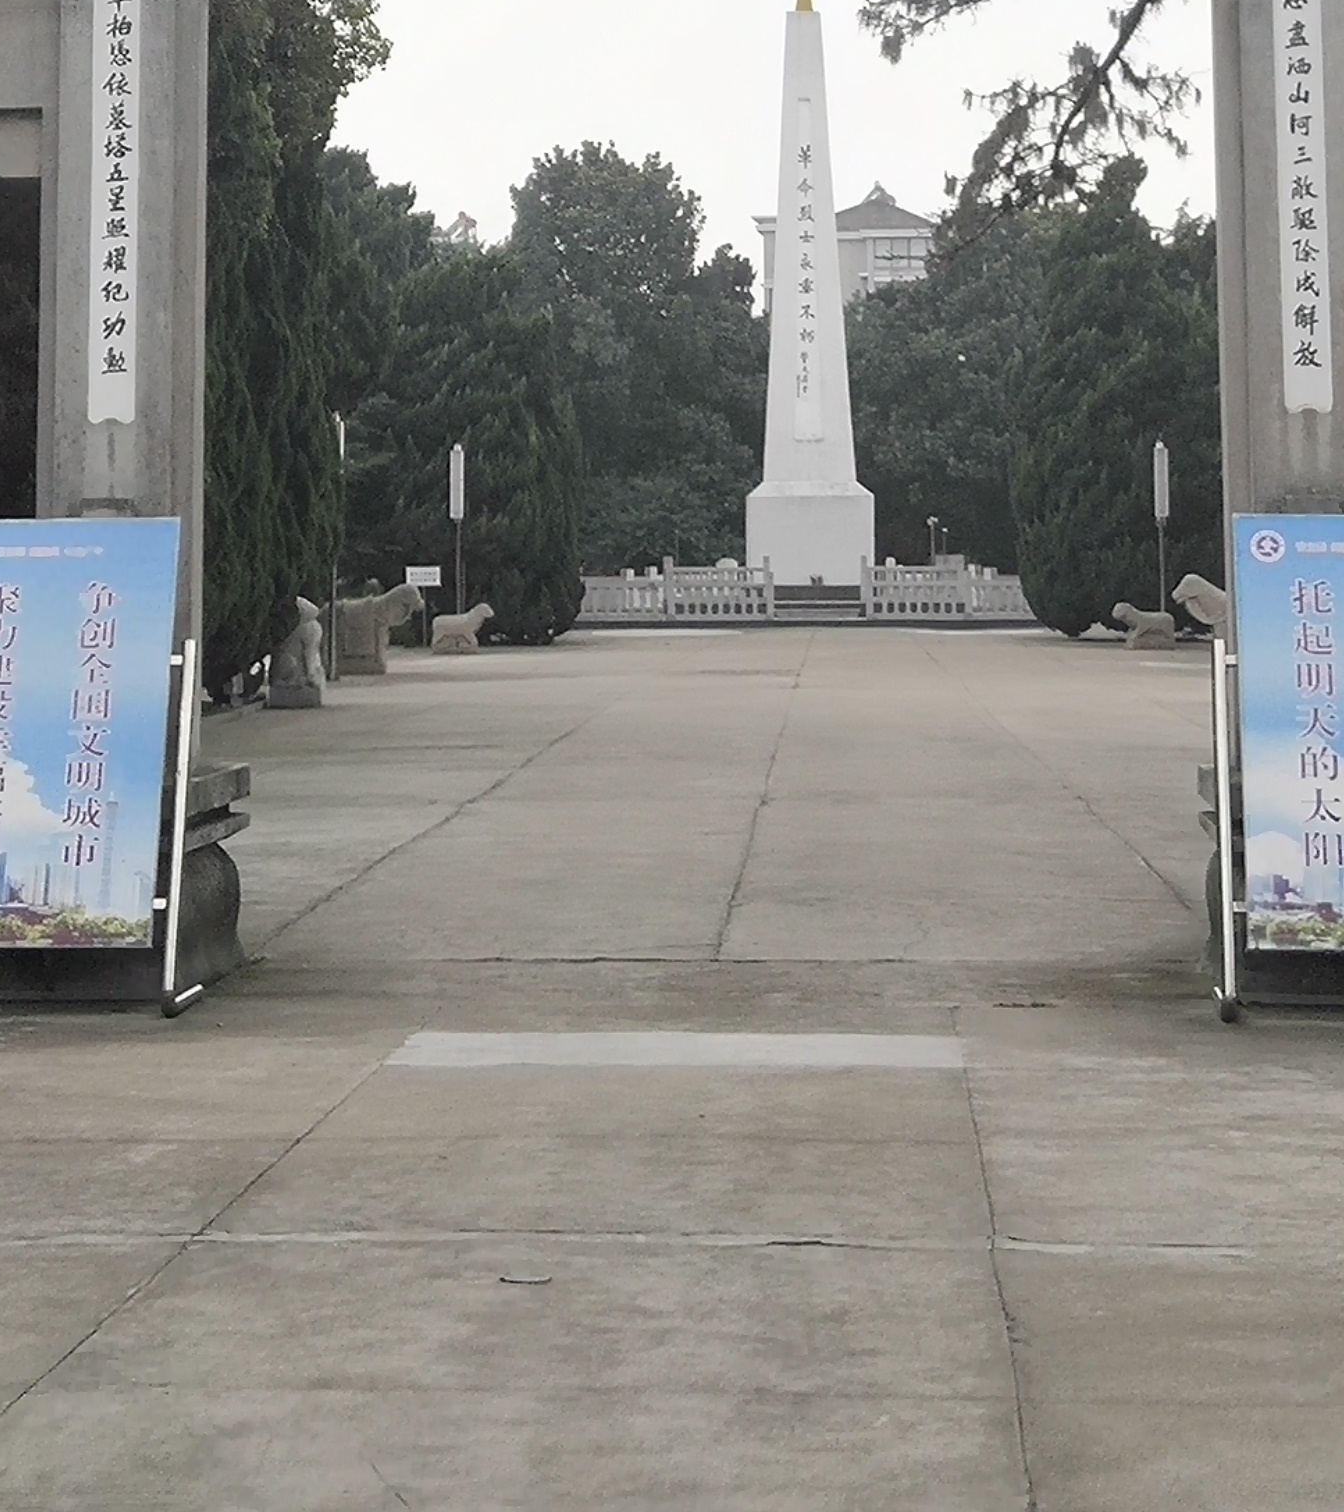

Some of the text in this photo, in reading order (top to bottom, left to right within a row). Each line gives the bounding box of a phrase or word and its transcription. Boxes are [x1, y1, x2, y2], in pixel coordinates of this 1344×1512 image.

[61, 579, 119, 868] 争创全国文明城市
[1291, 578, 1344, 869] 托起明天的太阳
